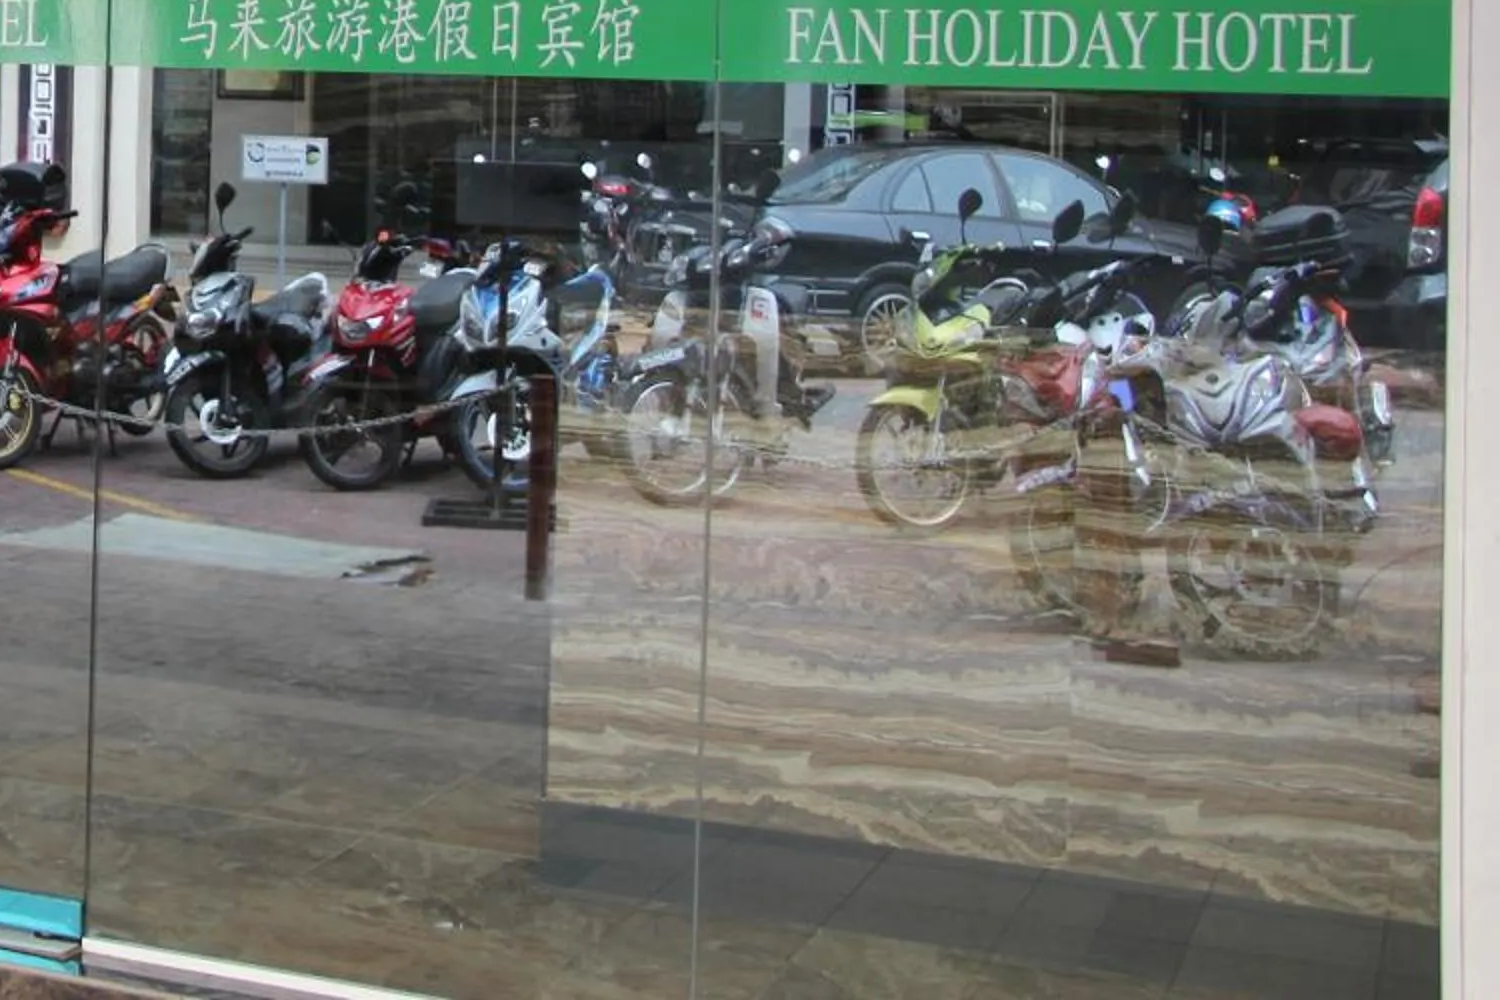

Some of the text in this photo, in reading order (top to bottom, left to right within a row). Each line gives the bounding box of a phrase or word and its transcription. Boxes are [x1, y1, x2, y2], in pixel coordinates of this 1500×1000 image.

[785, 7, 1374, 76] FAN HOLIDAY HOTEL
